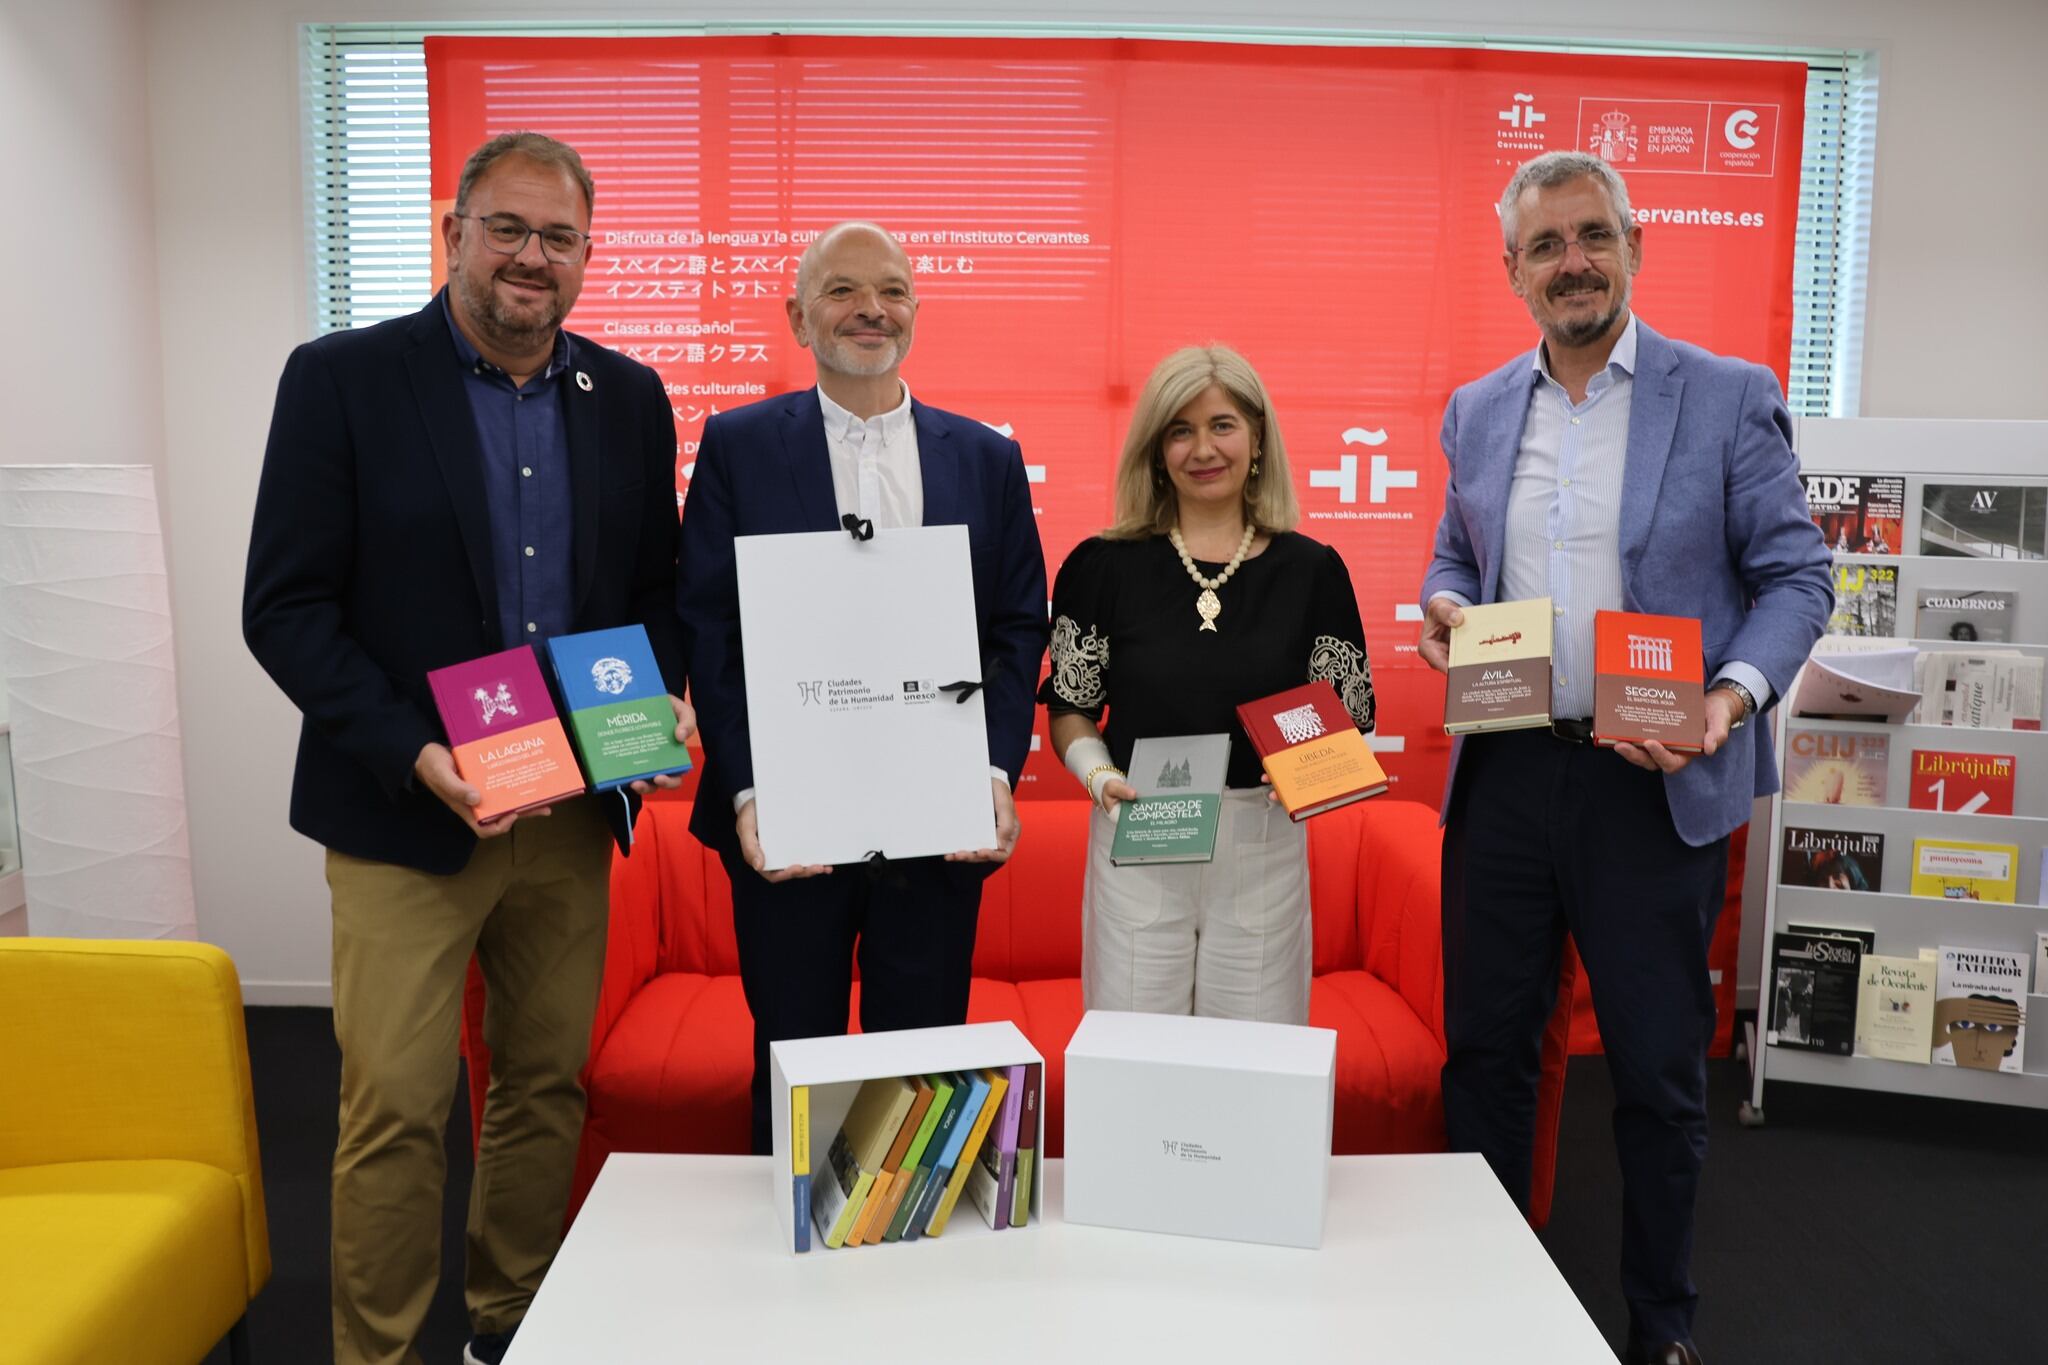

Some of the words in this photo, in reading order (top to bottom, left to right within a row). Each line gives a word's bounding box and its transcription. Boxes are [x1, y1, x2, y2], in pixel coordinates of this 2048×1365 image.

[1498, 130, 1544, 140] Instituto
[1648, 126, 1692, 136] EMBAJADA
[1496, 140, 1544, 150] Cervantes
[1648, 134, 1660, 143] DE
[1662, 134, 1694, 144] ESPAÑA
[1648, 144, 1659, 152] EN
[606, 232, 664, 244] Disfruta
[668, 232, 688, 244] de
[692, 231, 704, 244] la
[708, 231, 758, 247] lengua
[762, 234, 772, 246] y
[774, 230, 787, 243] la
[791, 230, 819, 244] cult
[910, 233, 929, 244] en
[933, 230, 946, 244] el
[950, 230, 1013, 244] Instituto
[1016, 231, 1090, 244] Cervantes
[604, 322, 650, 334] Clases
[654, 322, 673, 334] de
[676, 320, 734, 336] español
[692, 382, 766, 395] culturales
[1805, 476, 1860, 505] ADE
[1970, 490, 1998, 508] AV
[1308, 511, 1413, 520] www.tokio.cervantes.es
[1870, 568, 1894, 582] 322
[1926, 598, 2006, 610] CUADERNOS
[1482, 668, 1514, 680] ÁVILA
[828, 678, 862, 688] Ciudades
[828, 687, 870, 696] Patrimonio
[904, 692, 936, 700] unesco
[1625, 686, 1676, 700] SEGOVIA
[829, 697, 839, 706] de
[840, 696, 848, 704] la
[850, 694, 894, 704] Humanidad
[606, 712, 648, 728] MÉRIDA
[479, 750, 496, 764] LA
[496, 736, 545, 760] LAGUNA
[1792, 734, 1856, 758] CLIJ
[1919, 754, 2010, 780] Librújula
[1132, 800, 1186, 812] SANTIAGO
[1188, 800, 1202, 810] DE
[1128, 809, 1202, 822] COMPOSTELA
[1791, 830, 1877, 856] Librújula
[1881, 965, 1916, 978] Revista
[1956, 963, 2022, 978] EXTERIOR
[1867, 973, 1880, 986] de
[1882, 978, 1928, 992] Occidente
